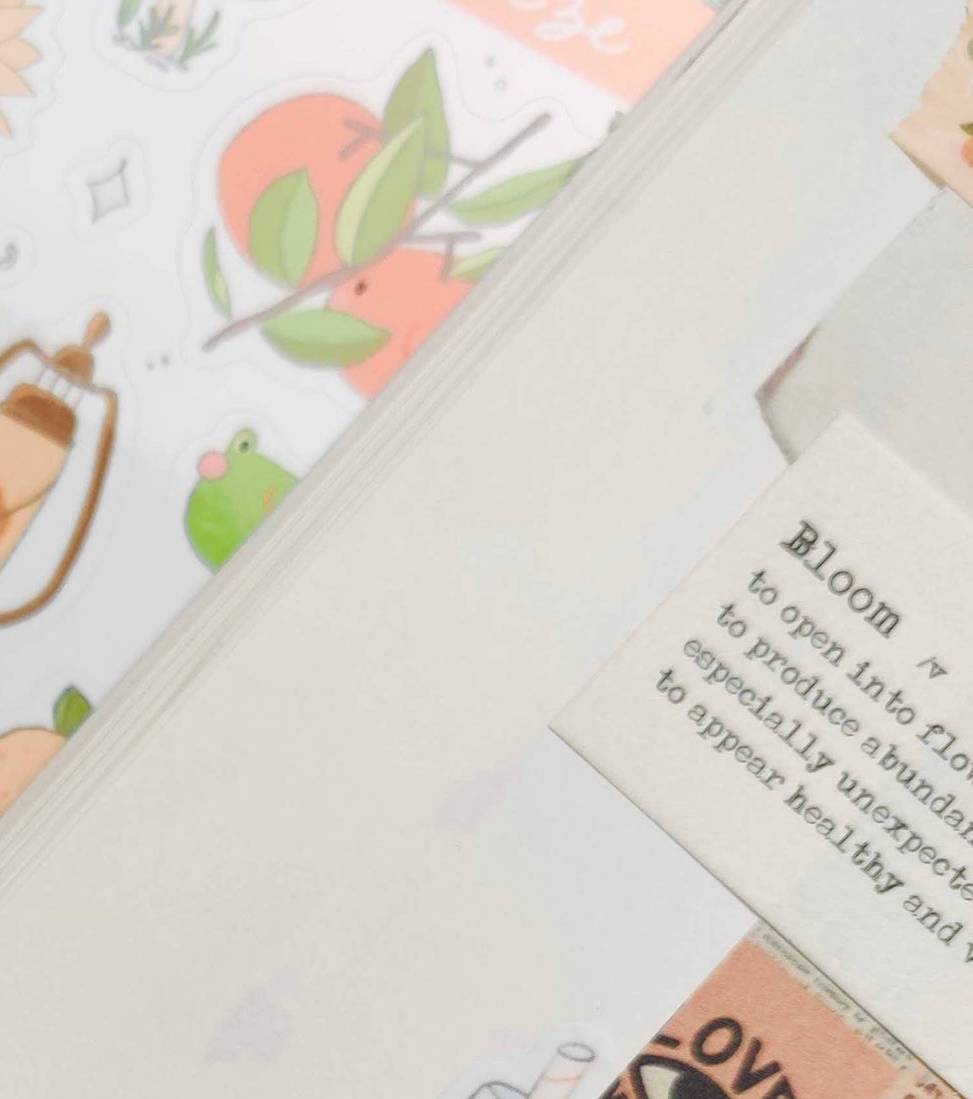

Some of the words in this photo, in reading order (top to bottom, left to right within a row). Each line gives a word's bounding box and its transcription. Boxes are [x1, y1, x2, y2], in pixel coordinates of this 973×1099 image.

[747, 569, 778, 605] to
[780, 606, 845, 667] open
[846, 661, 915, 725] into
[779, 520, 900, 638] Bloom
[716, 603, 747, 638] to
[743, 637, 860, 736] produce
[656, 669, 686, 704] to
[687, 704, 786, 790] appear
[783, 784, 904, 894] healthy
[903, 895, 963, 946] and
[684, 640, 835, 773] especially
[836, 771, 973, 901] unexpecte
